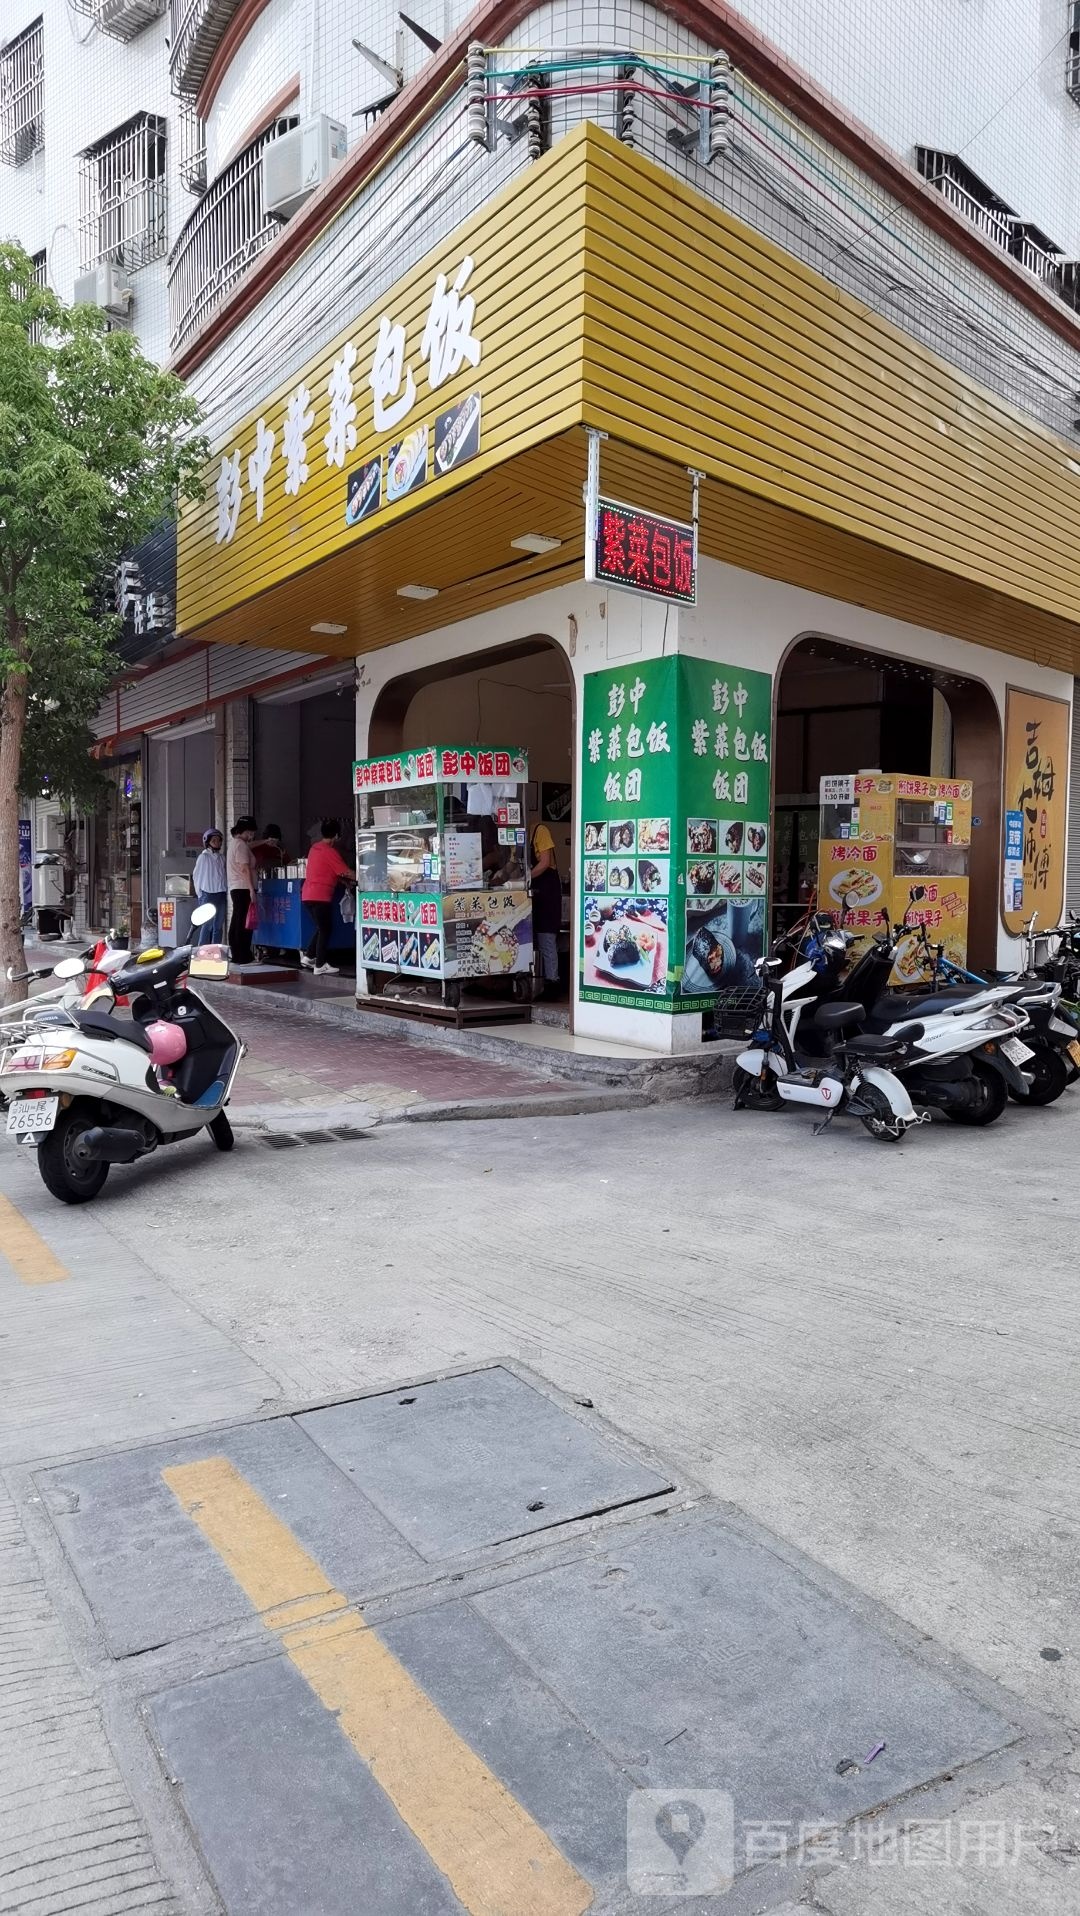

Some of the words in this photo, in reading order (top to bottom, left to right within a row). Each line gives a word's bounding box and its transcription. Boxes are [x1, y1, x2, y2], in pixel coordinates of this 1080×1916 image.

[215, 256, 481, 544] 彭中紫菜包饭
[602, 511, 692, 594] 紫菜包饭
[607, 677, 646, 717] 彭中
[712, 678, 749, 718] 彭中
[588, 721, 671, 763] 紫菜包饭
[691, 718, 768, 763] 紫菜包饭
[355, 758, 402, 788] 彭中紫菜包饭
[416, 752, 434, 779] 饭团
[442, 751, 510, 776] 彭中饭团
[604, 768, 642, 801] 饭团
[712, 769, 749, 804] 饭团
[899, 780, 929, 796] 煎饼果子
[832, 846, 878, 861] 烤冷面
[362, 899, 406, 923] 彭中紫菜包饭
[421, 902, 437, 925] 饭团
[454, 895, 516, 911] 紫菜包饭
[9, 1112, 52, 1130] 26556
